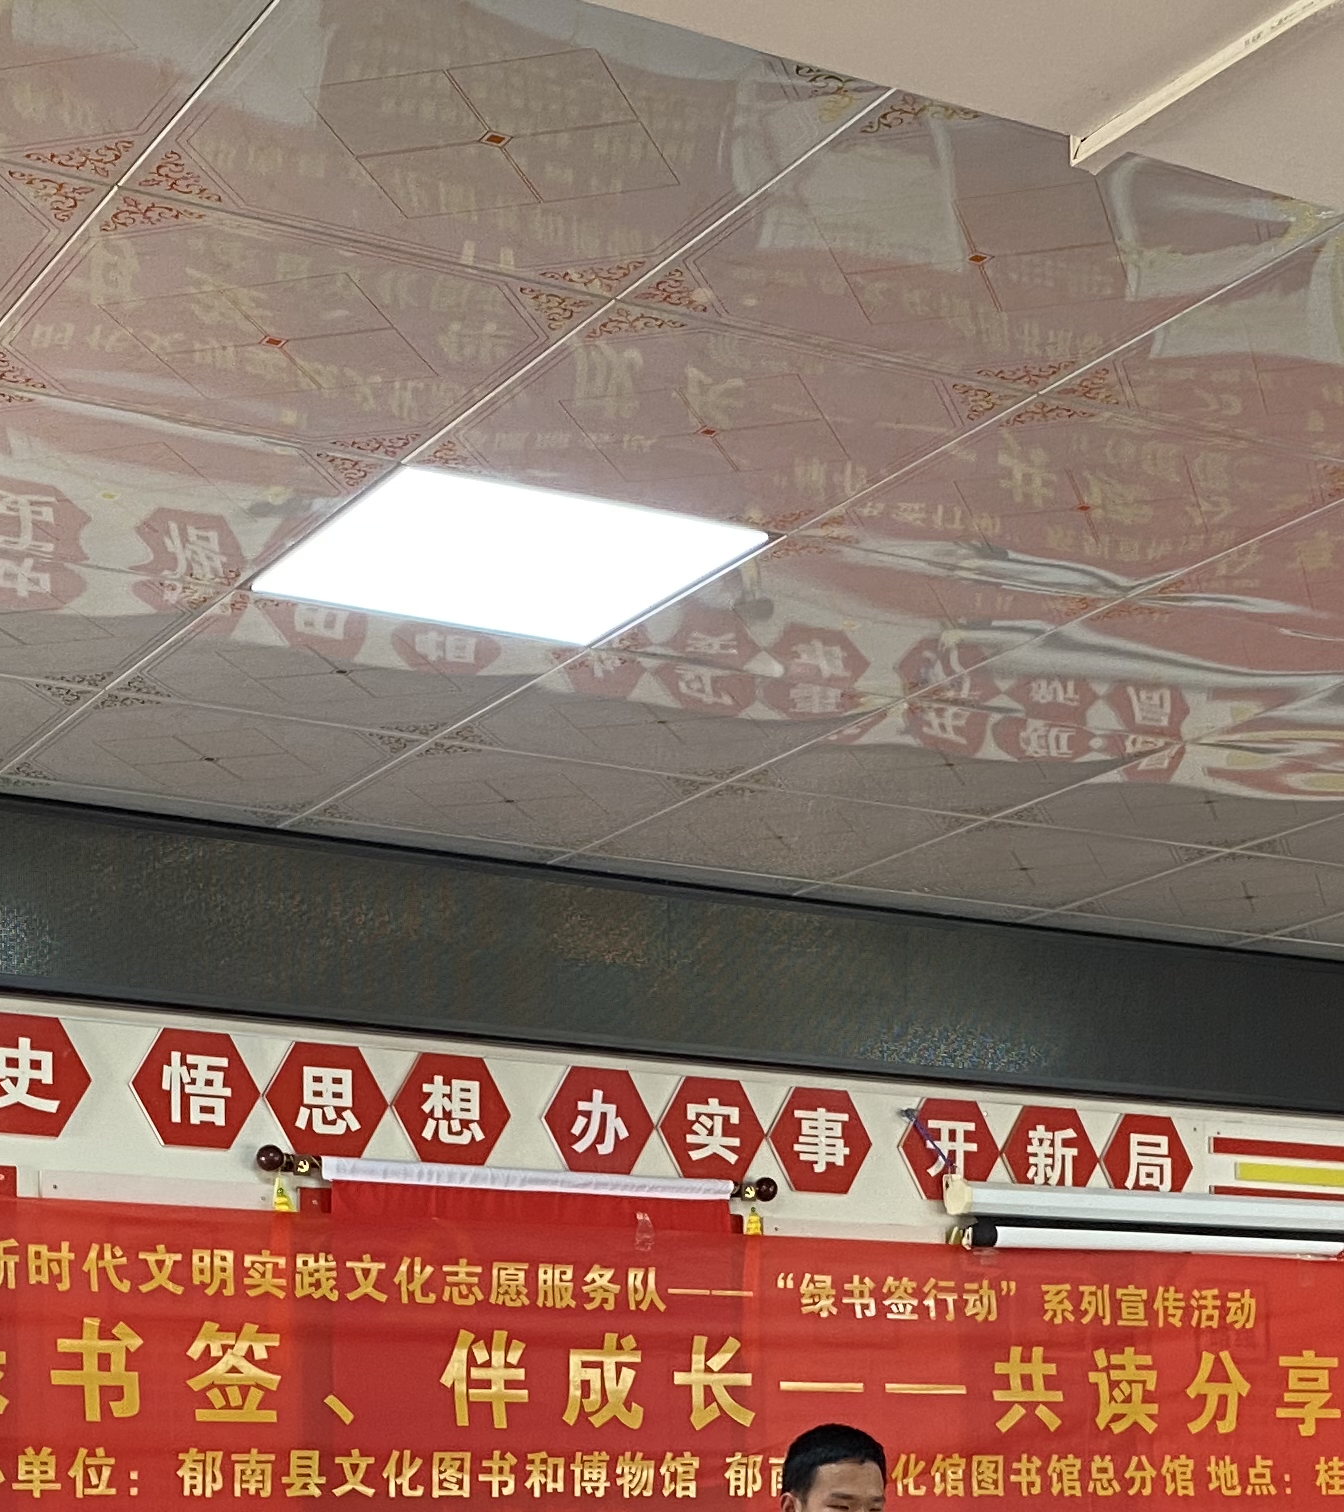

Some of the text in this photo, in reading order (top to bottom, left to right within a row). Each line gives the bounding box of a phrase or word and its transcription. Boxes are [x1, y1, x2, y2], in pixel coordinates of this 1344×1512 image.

[161, 1052, 487, 1146] 悟思想
[570, 1089, 851, 1174] 办实事
[926, 1120, 1172, 1192] 开新局
